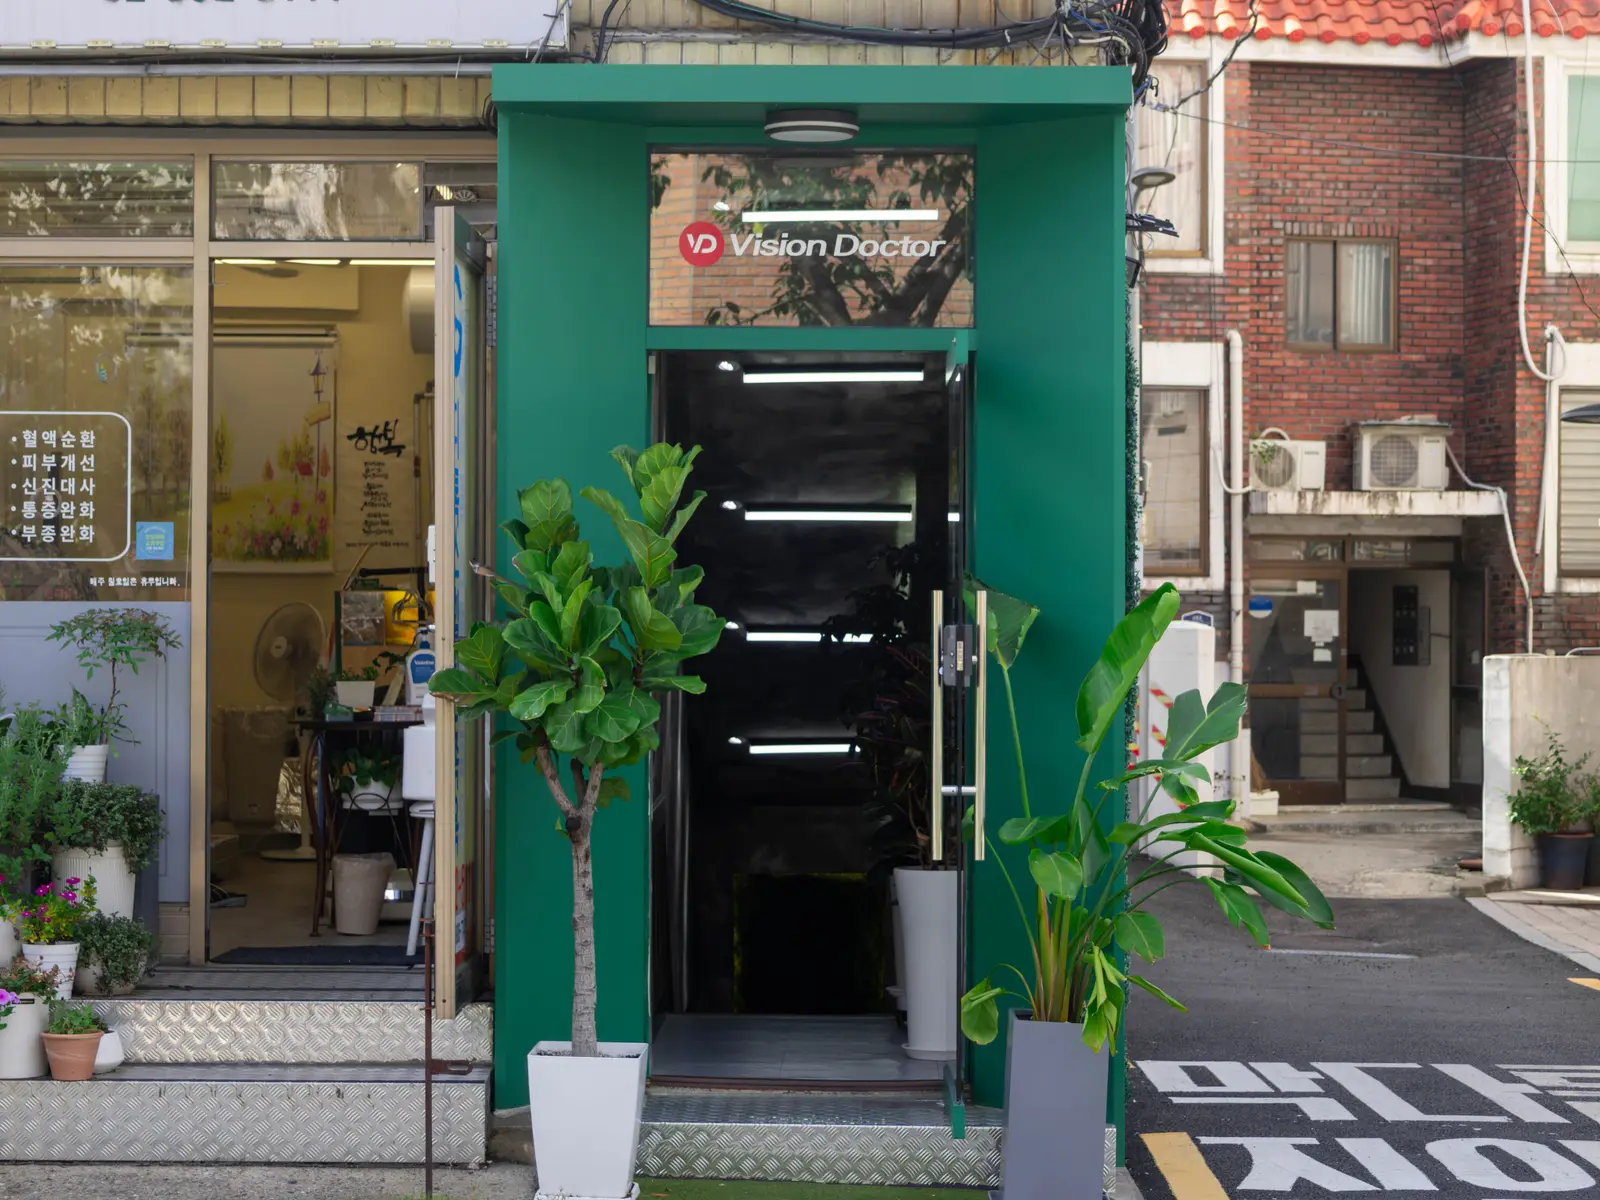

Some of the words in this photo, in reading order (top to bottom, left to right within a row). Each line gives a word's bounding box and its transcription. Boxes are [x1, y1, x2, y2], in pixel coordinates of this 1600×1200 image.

[730, 232, 827, 257] Vision
[833, 233, 946, 257] Doctor
[22, 430, 95, 448] 혈액순환
[22, 454, 95, 472] 피부개선
[22, 477, 95, 495] 신진대사
[22, 501, 95, 519] 통증완화
[22, 525, 94, 542] 부종완화
